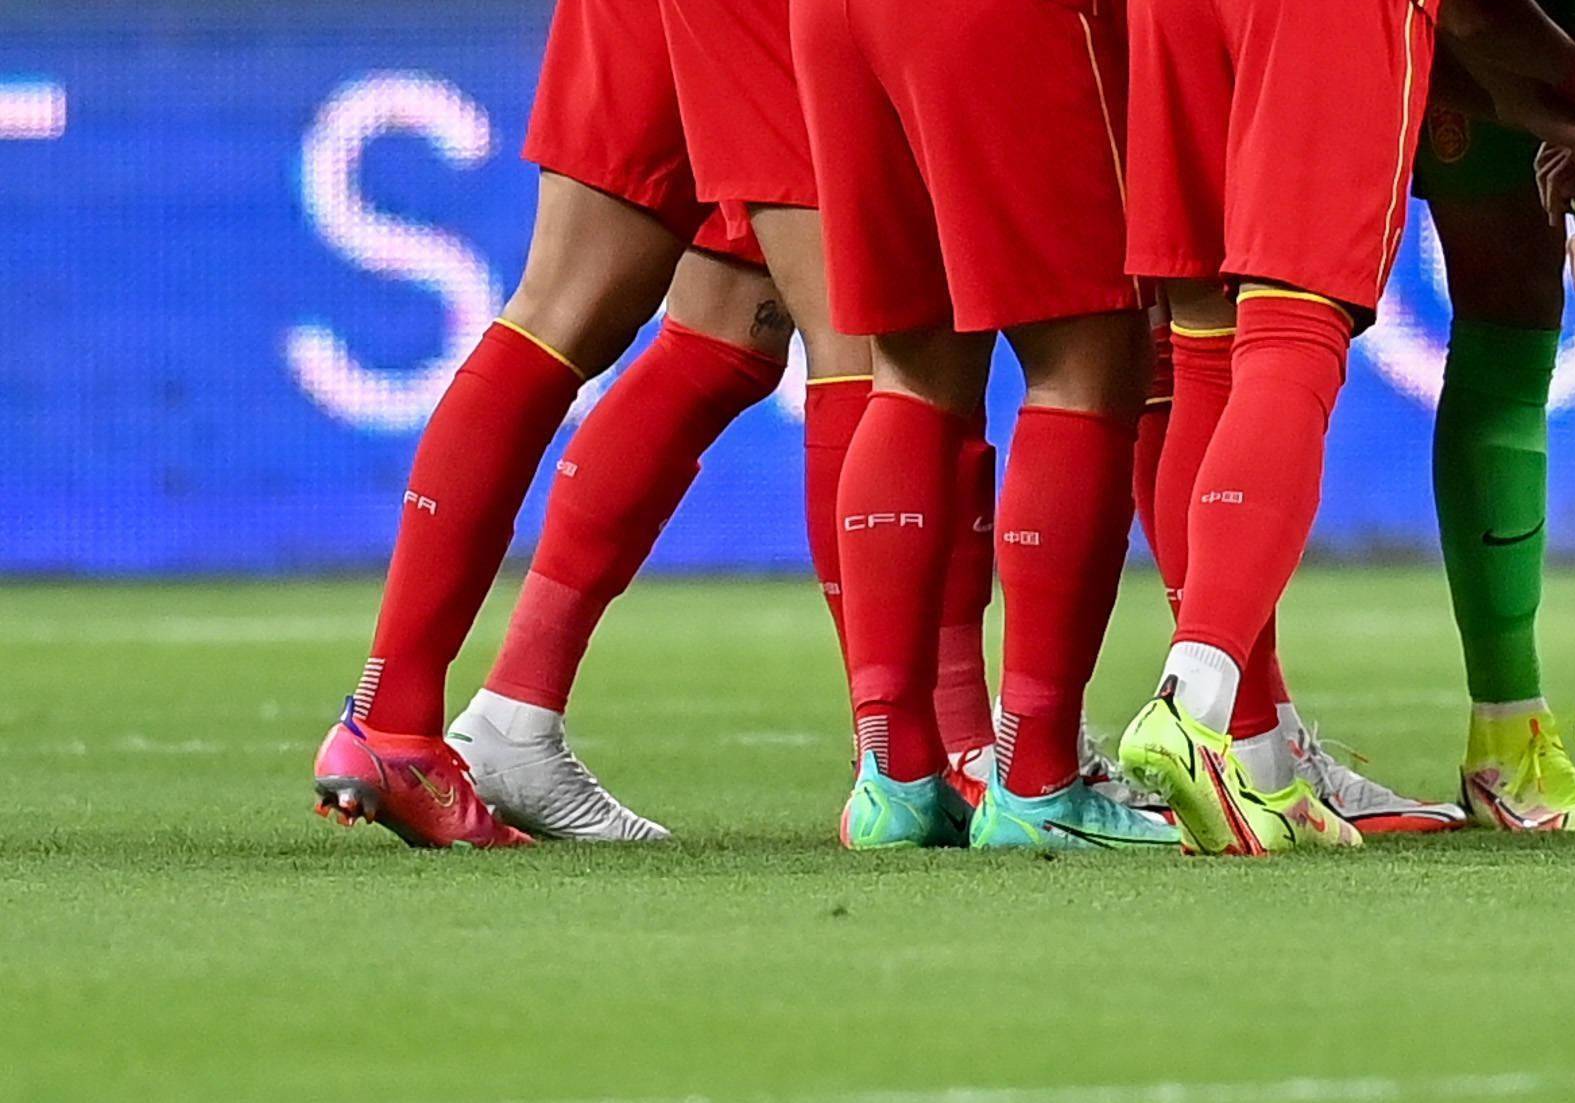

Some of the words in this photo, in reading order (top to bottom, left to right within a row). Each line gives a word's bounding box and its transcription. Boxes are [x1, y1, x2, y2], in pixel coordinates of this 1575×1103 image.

[403, 490, 437, 516] FA
[844, 512, 924, 532] CFA
[1003, 530, 1041, 546] 中国
